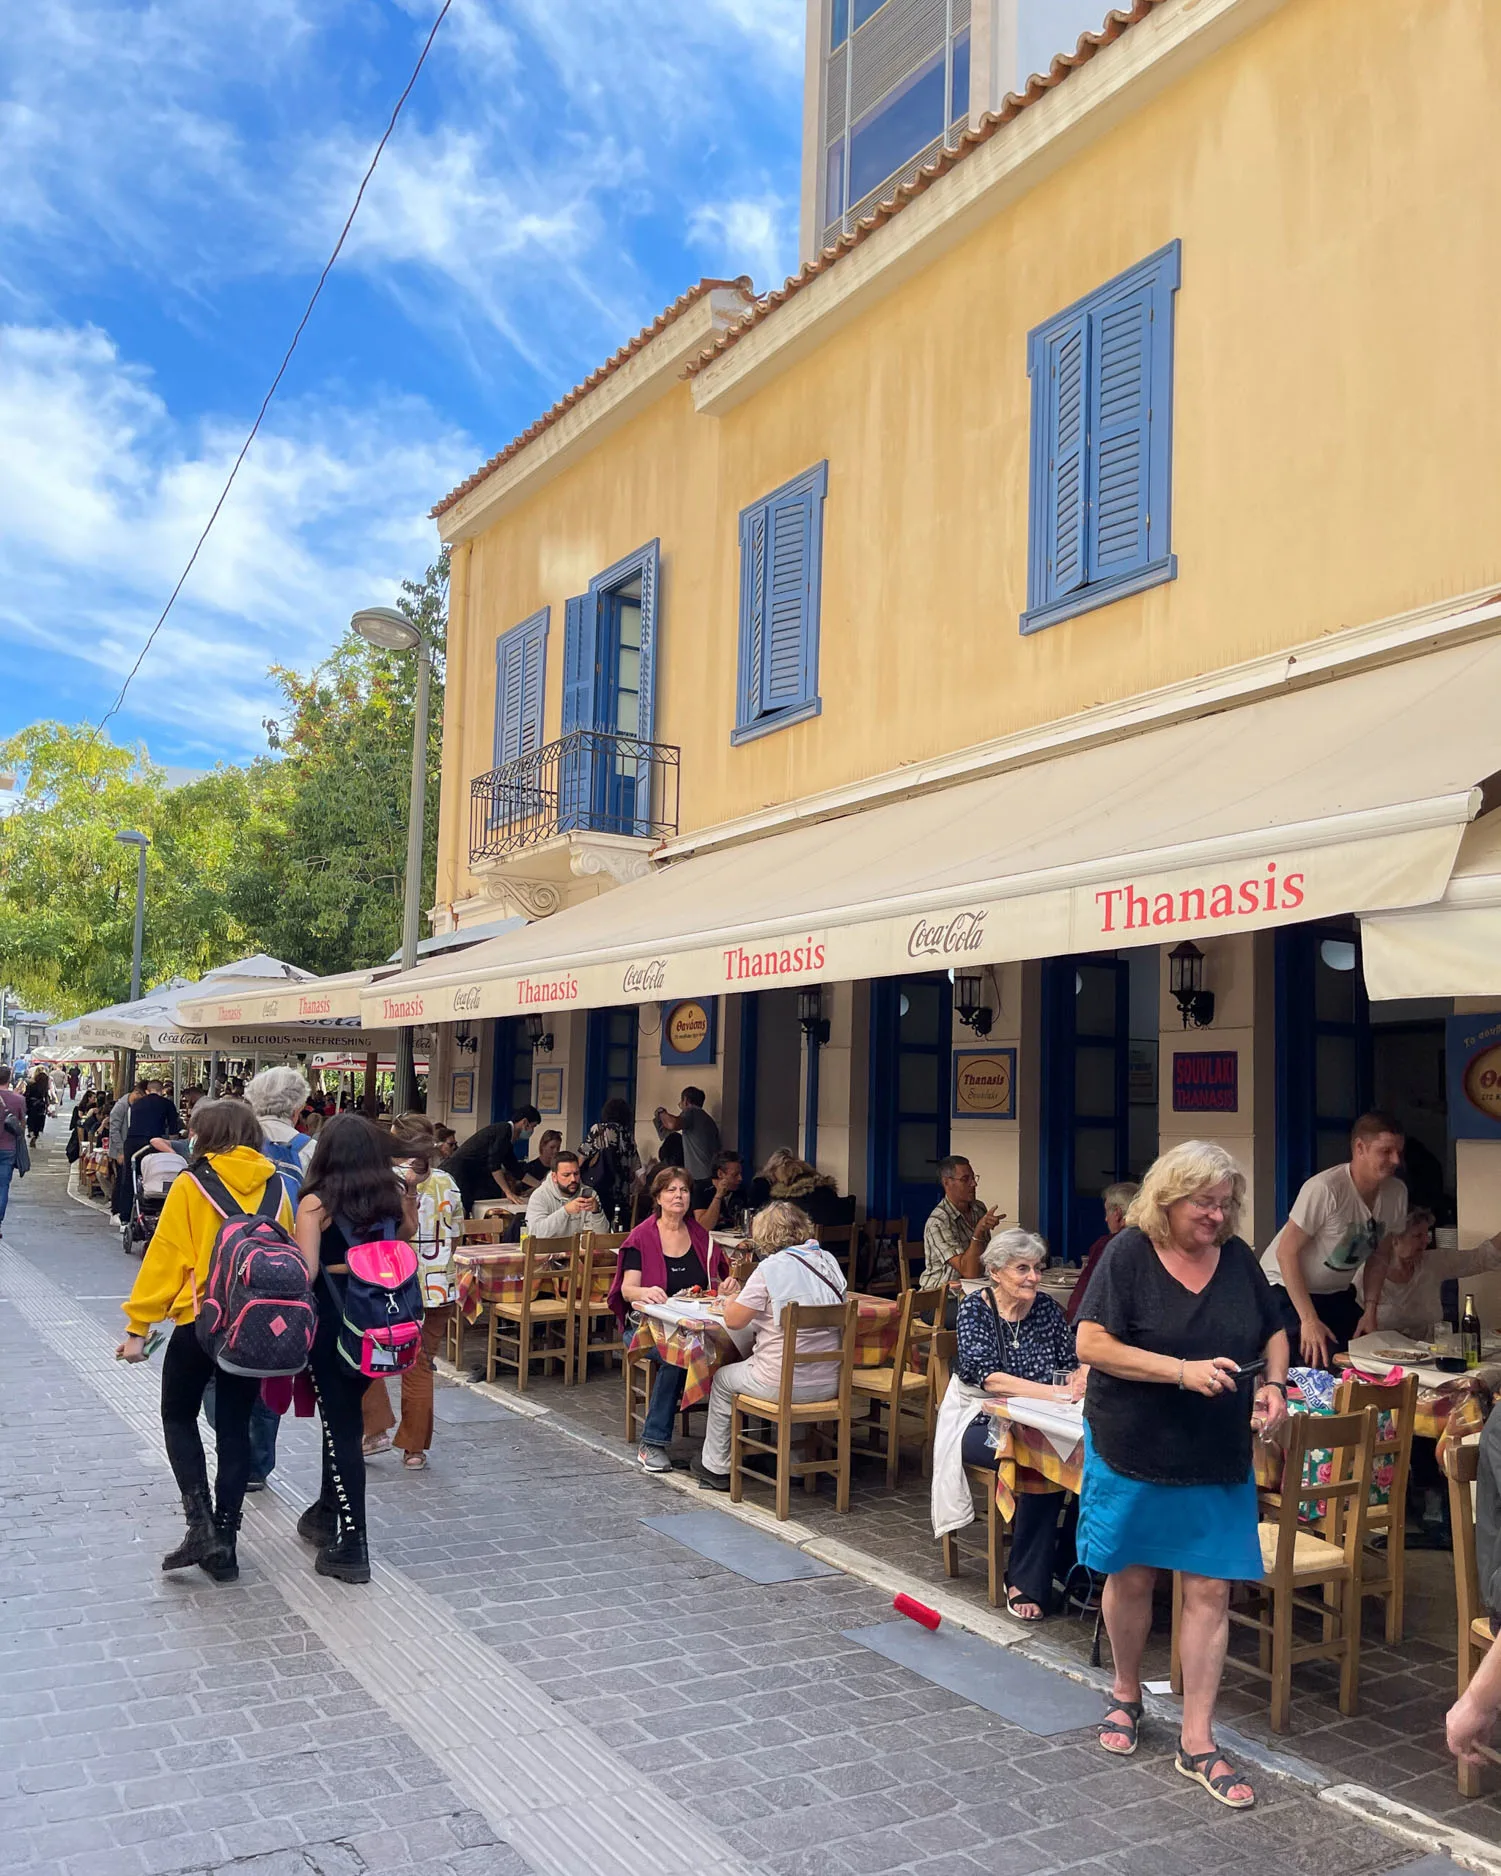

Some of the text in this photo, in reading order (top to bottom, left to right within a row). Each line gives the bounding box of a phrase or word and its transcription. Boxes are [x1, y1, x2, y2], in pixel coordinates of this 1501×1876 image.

[384, 994, 423, 1019] Thanasis
[517, 973, 578, 1004] Thanasis
[723, 936, 825, 981] Thanasis
[1095, 862, 1305, 932] Thanasis
[299, 995, 331, 1015] Thanasis
[232, 1035, 290, 1044] DELICIOUS
[308, 1036, 372, 1047] REFRESHING
[964, 1073, 1004, 1086] Thanasis
[1177, 1056, 1234, 1085] SOUVLAKI
[1176, 1088, 1234, 1107] THANASIS
[323, 1421, 336, 1457] DKNY
[333, 1475, 351, 1510] DKNY
